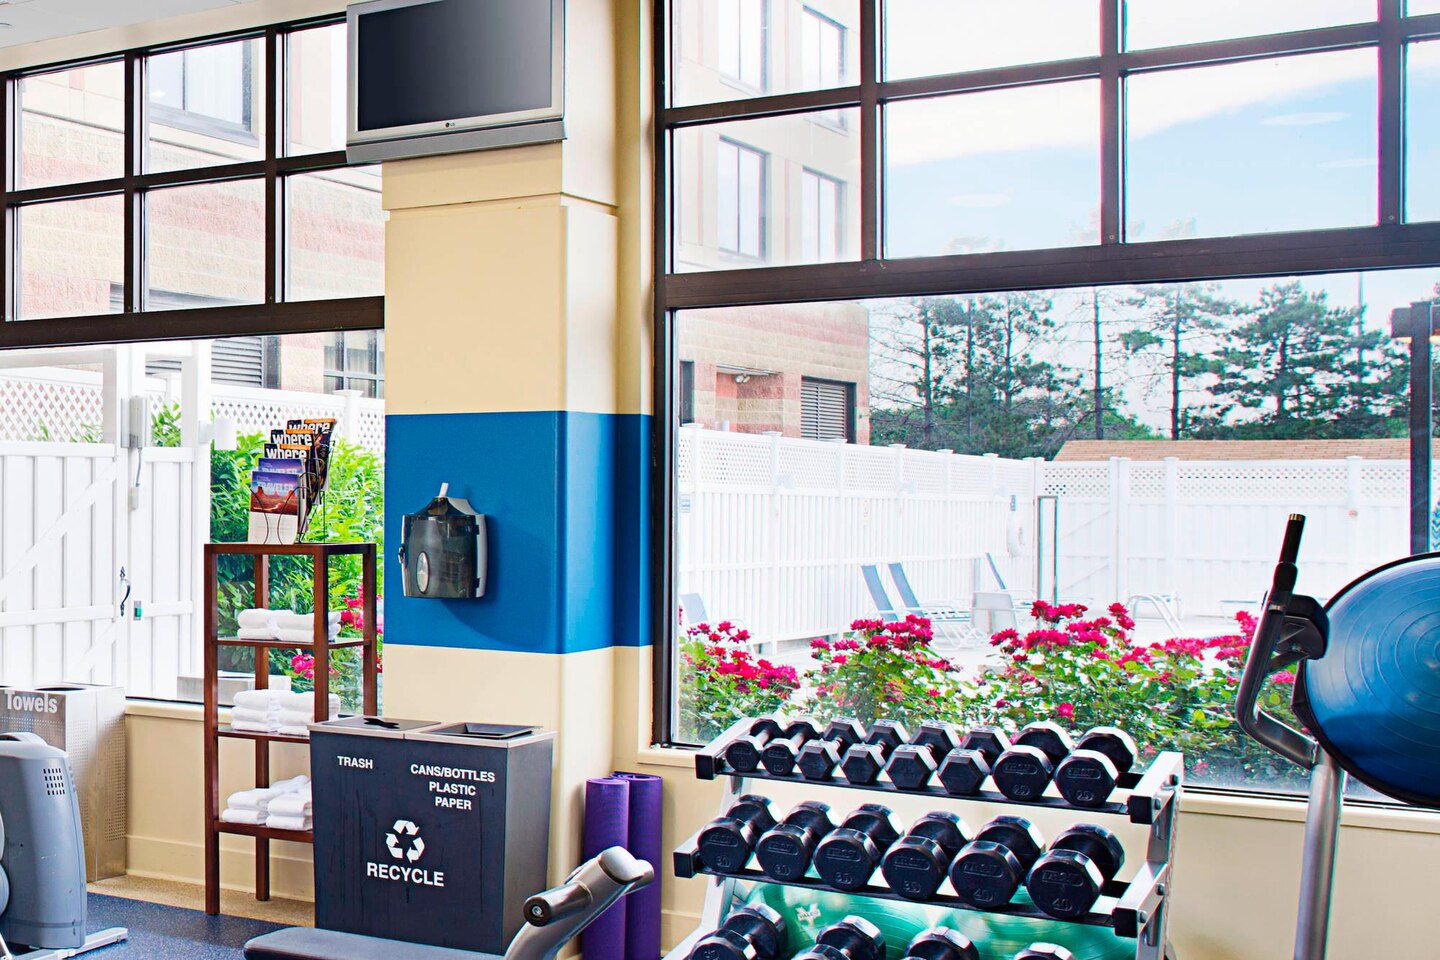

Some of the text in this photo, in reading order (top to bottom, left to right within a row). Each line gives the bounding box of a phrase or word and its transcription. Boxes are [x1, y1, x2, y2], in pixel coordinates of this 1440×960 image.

[272, 430, 312, 446] where
[266, 445, 307, 459] where
[4, 690, 58, 713] Towels
[337, 755, 373, 769] TRASH
[410, 764, 496, 782] CANS/BOTTLES
[429, 782, 476, 796] PLASTIC
[435, 797, 472, 810] PAPER
[367, 862, 444, 887] RECYCLE
